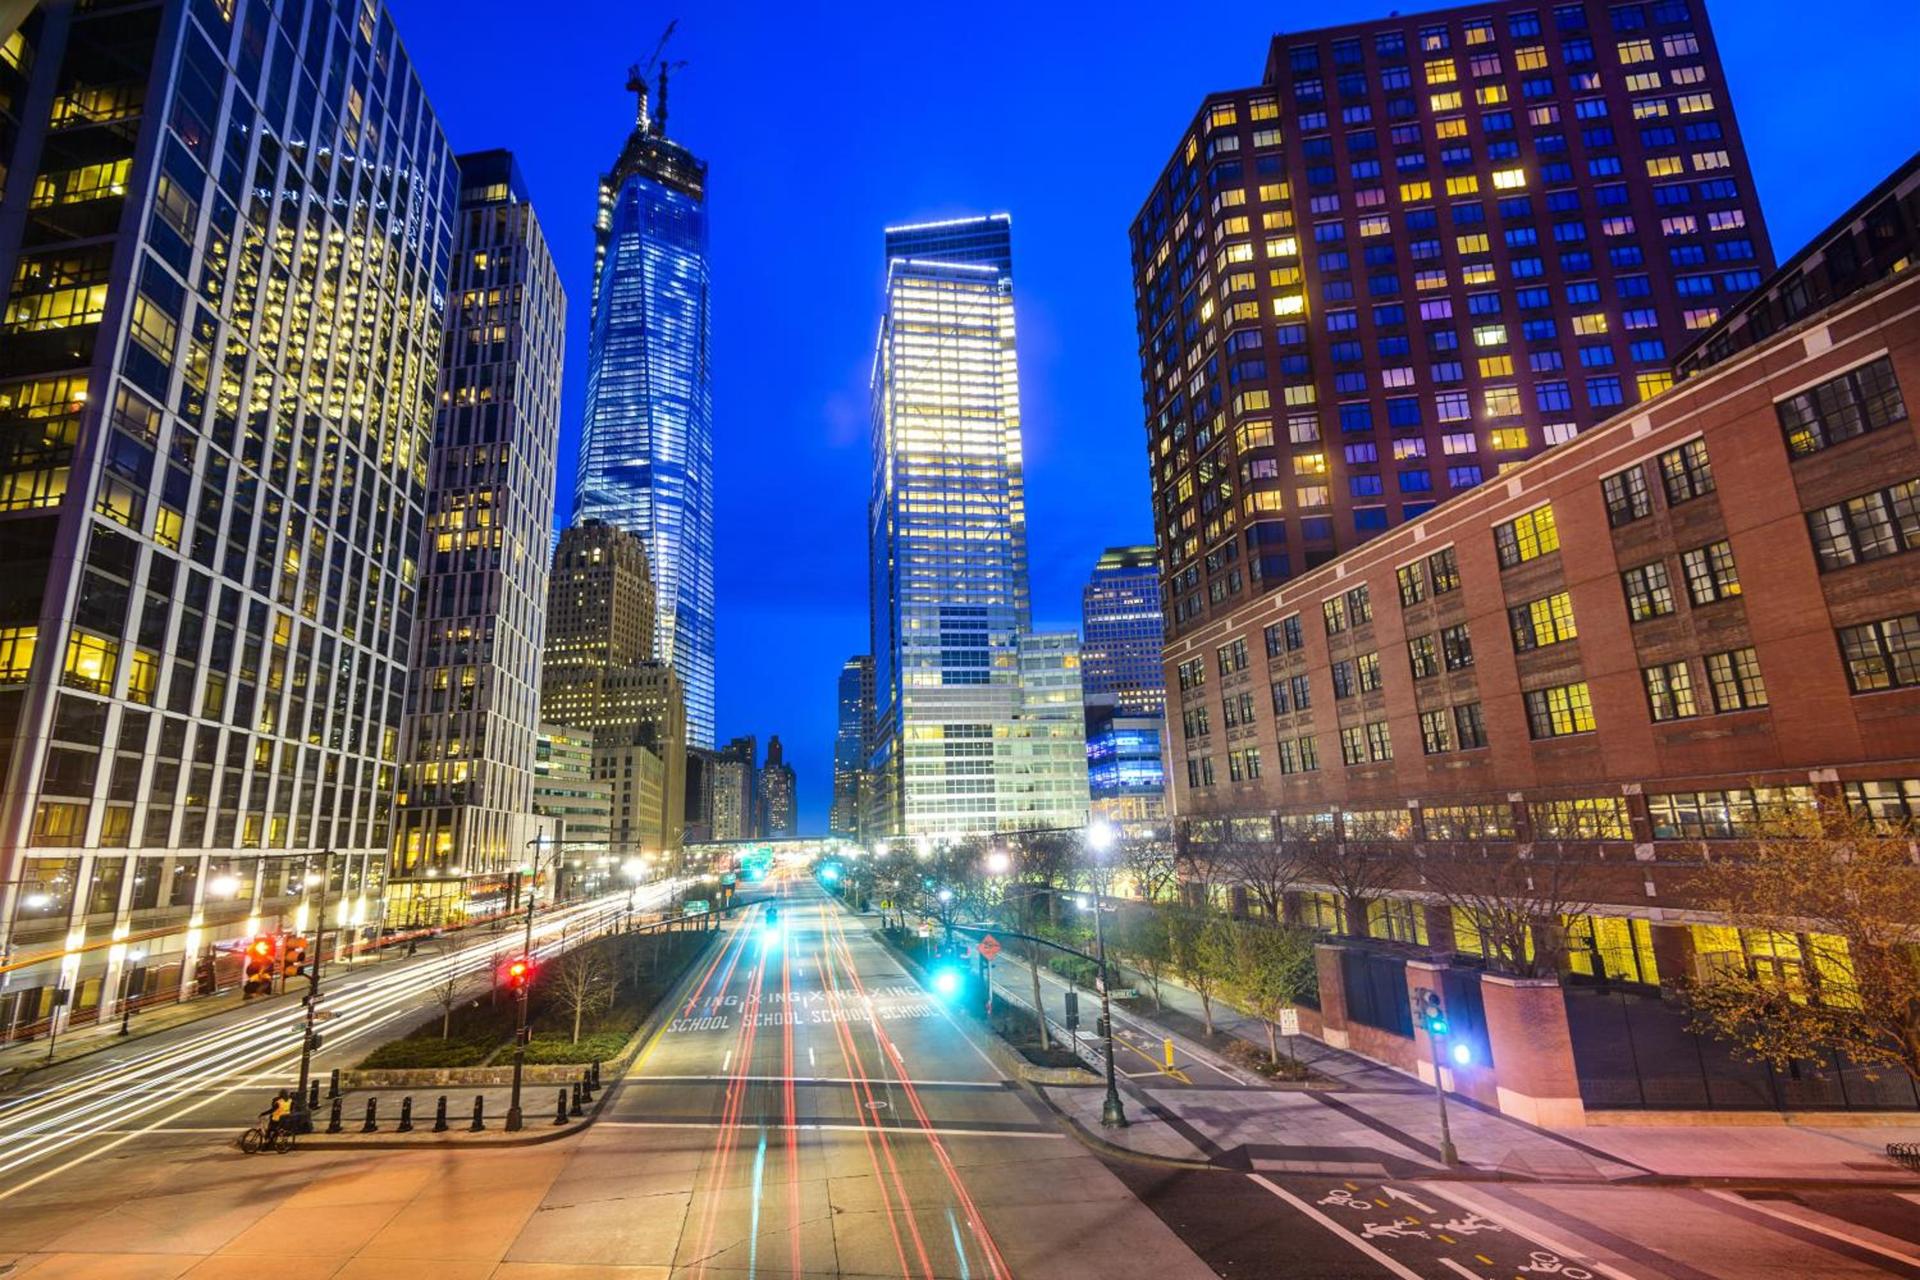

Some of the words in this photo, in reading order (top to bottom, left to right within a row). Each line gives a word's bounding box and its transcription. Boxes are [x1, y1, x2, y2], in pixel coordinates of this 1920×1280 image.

[742, 1010, 804, 1027] SCHOOL
[811, 1006, 872, 1024] SCHOOL
[879, 1003, 941, 1020] SCHOOL
[667, 1015, 730, 1033] SCHOOL
